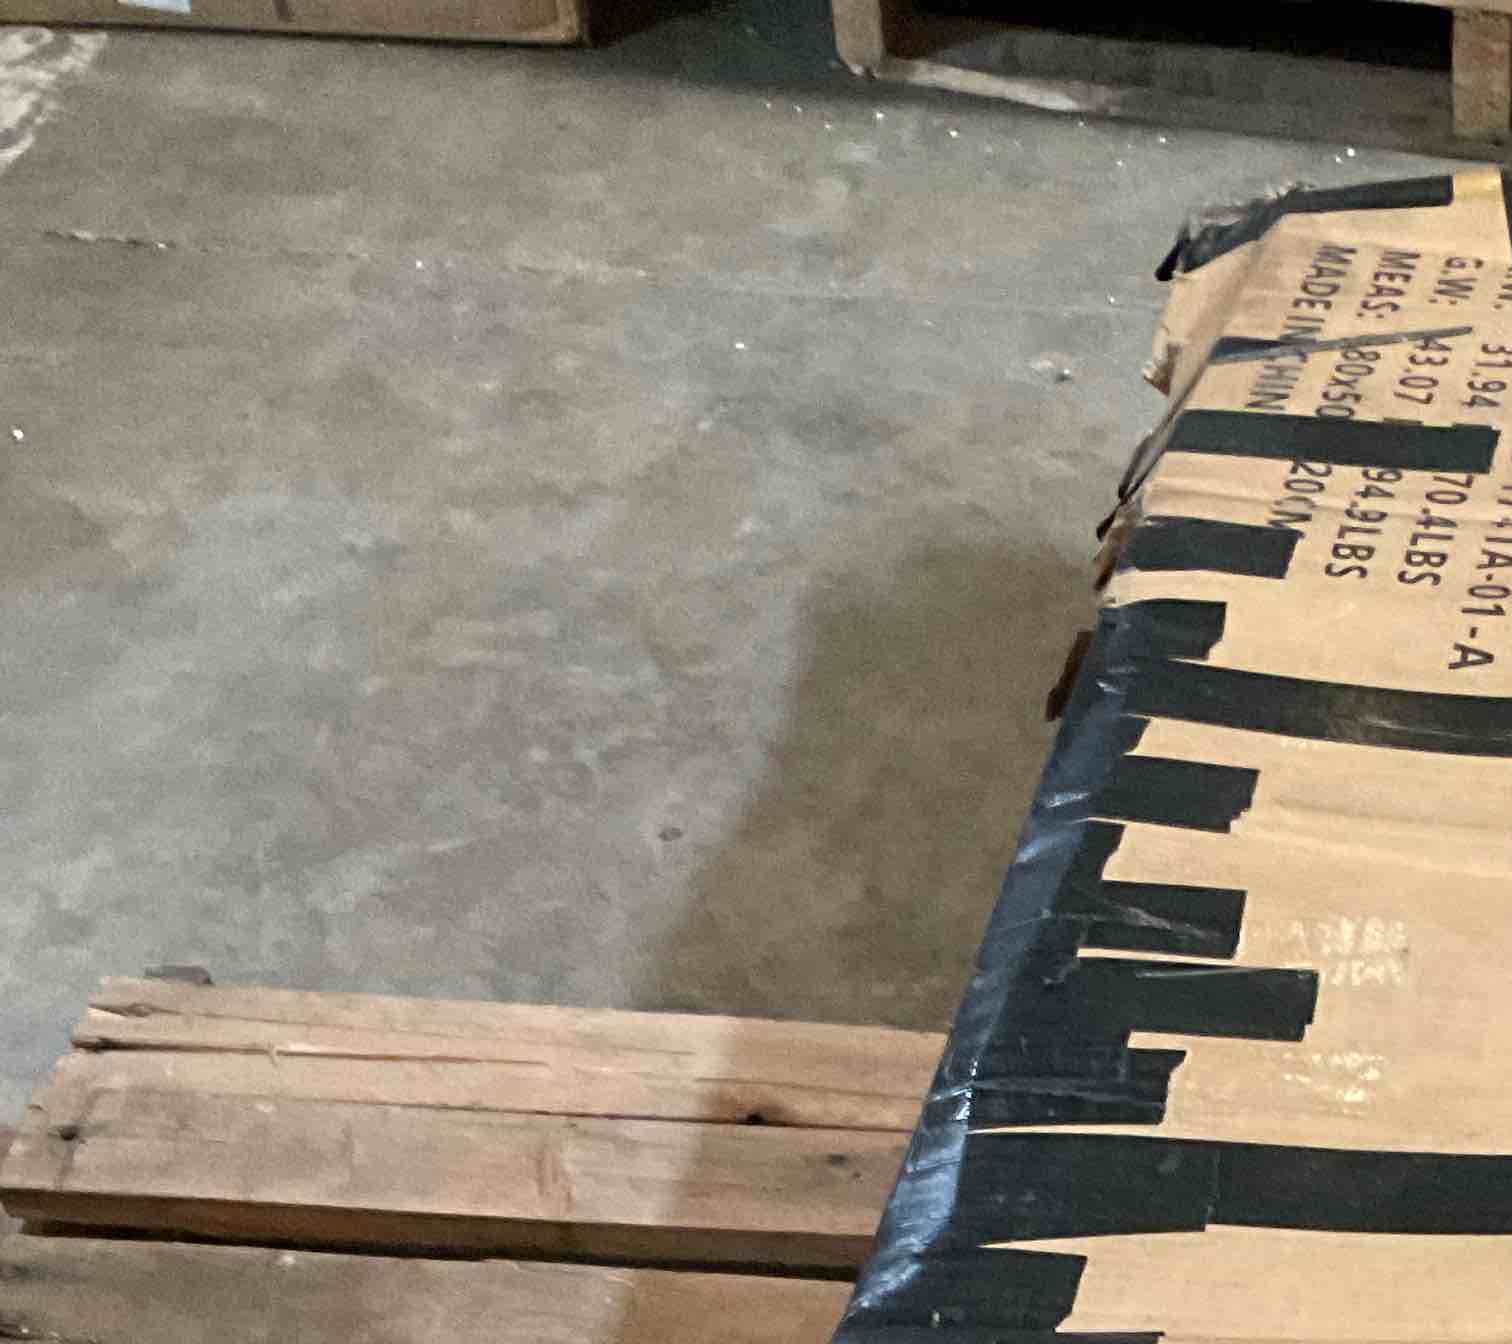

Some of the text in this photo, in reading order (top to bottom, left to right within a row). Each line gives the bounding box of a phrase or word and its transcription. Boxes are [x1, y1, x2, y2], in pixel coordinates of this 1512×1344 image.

[1292, 244, 1358, 311] MADE
[1356, 250, 1422, 320] MEAS:
[1427, 255, 1485, 306] G.W:
